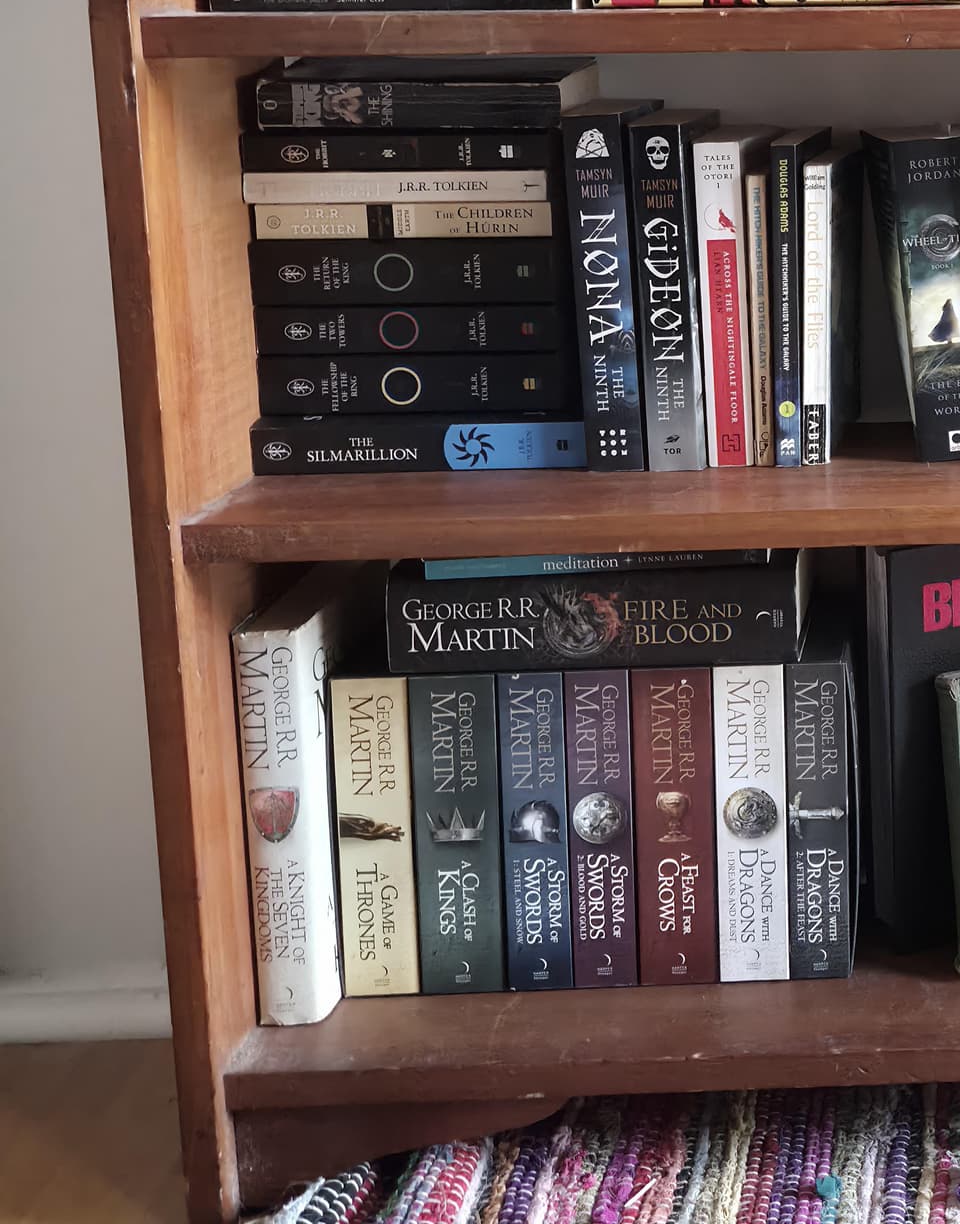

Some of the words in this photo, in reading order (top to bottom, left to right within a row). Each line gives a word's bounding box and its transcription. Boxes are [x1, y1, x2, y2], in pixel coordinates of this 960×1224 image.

[704, 154, 731, 162] TALES
[909, 156, 957, 169] ROBERT
[575, 168, 613, 181] TAMSYN
[398, 181, 431, 193] J.R.R.
[433, 181, 488, 192] TOLKIEN
[581, 184, 609, 199] MUIR
[641, 179, 678, 192] TAMSYN
[646, 194, 675, 209] MUIR
[349, 437, 374, 447] THE
[307, 448, 418, 462] SILMARILLION
[664, 448, 682, 456] TOR
[543, 556, 618, 572] meditation
[624, 599, 688, 621] FIRE
[699, 603, 742, 619] AND
[634, 623, 733, 645] BLOOD
